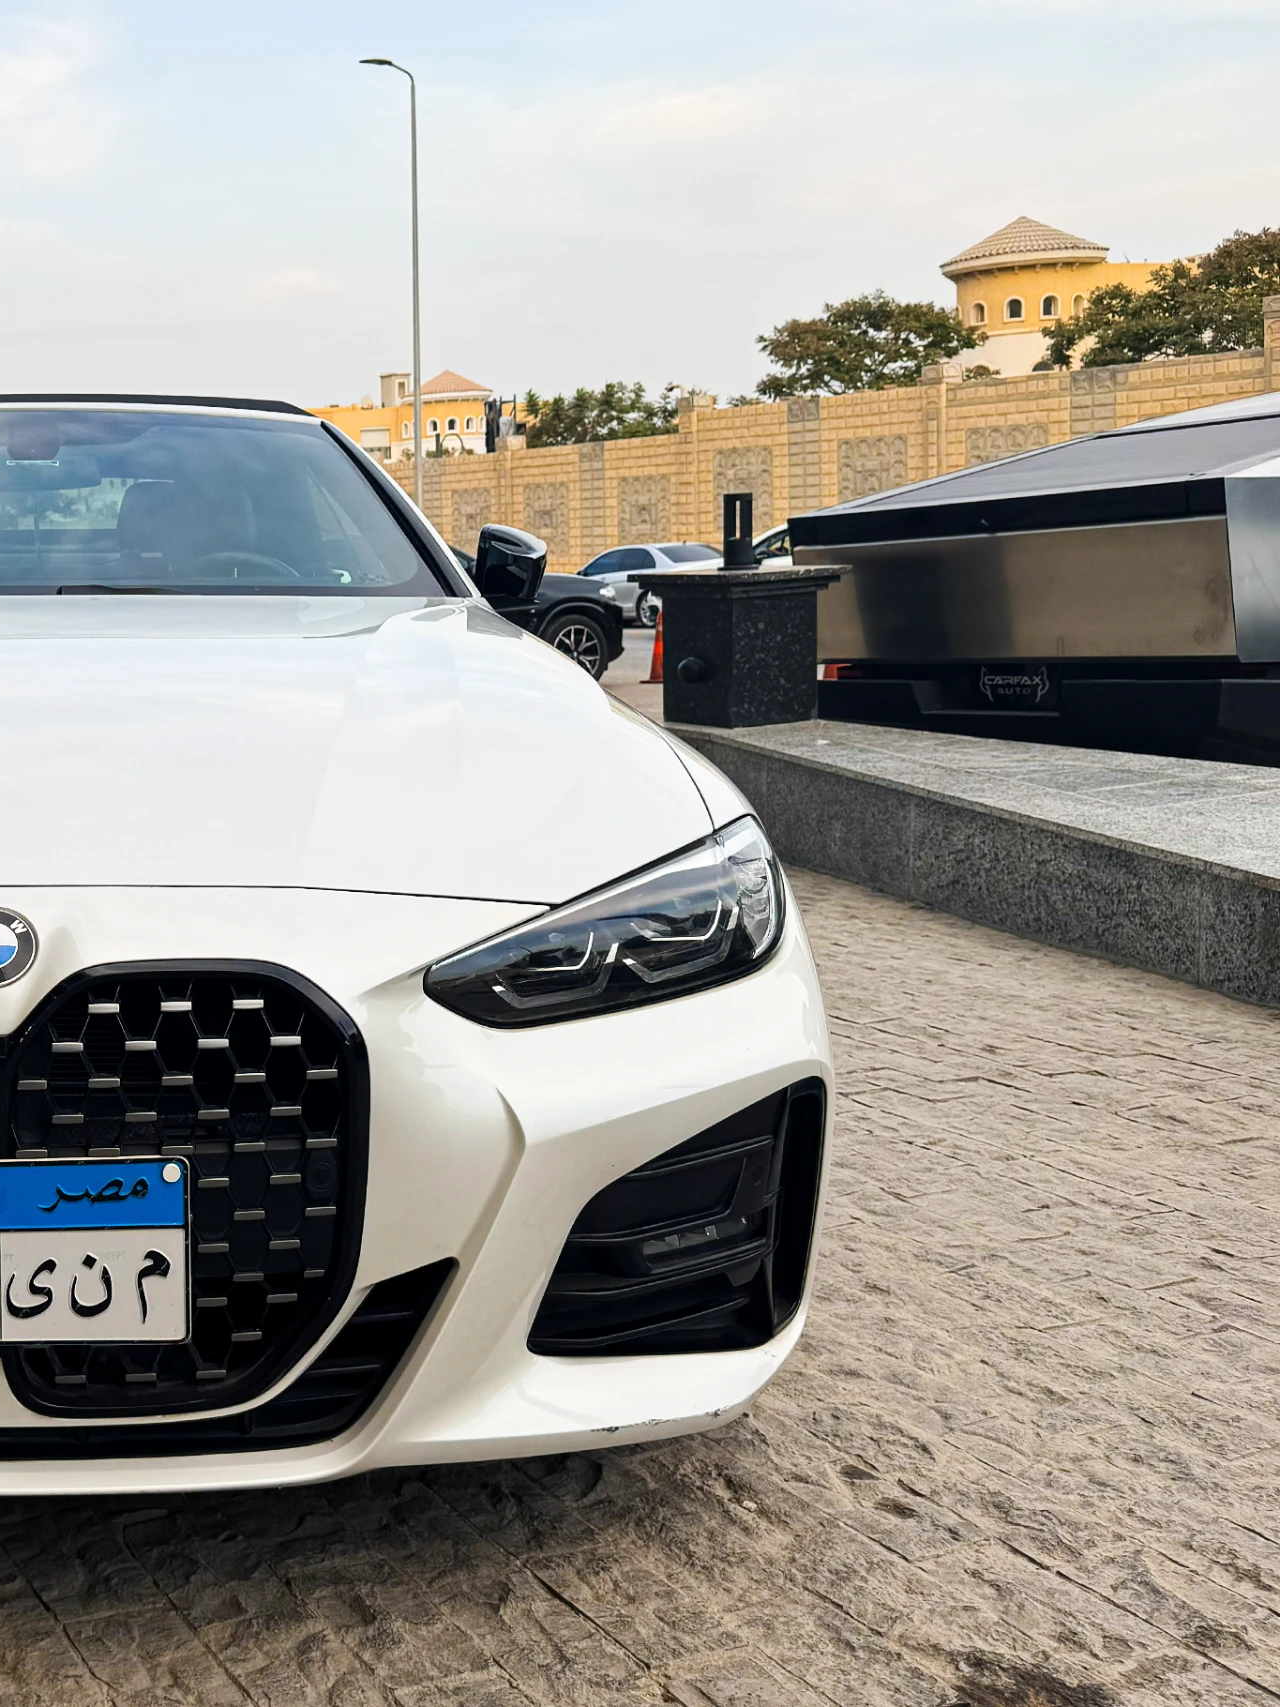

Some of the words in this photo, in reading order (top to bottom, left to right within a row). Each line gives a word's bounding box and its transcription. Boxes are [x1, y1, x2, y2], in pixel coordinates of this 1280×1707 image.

[984, 675, 1042, 685] CARFAX
[997, 687, 1031, 695] AUTO
[37, 1177, 150, 1214] مصر
